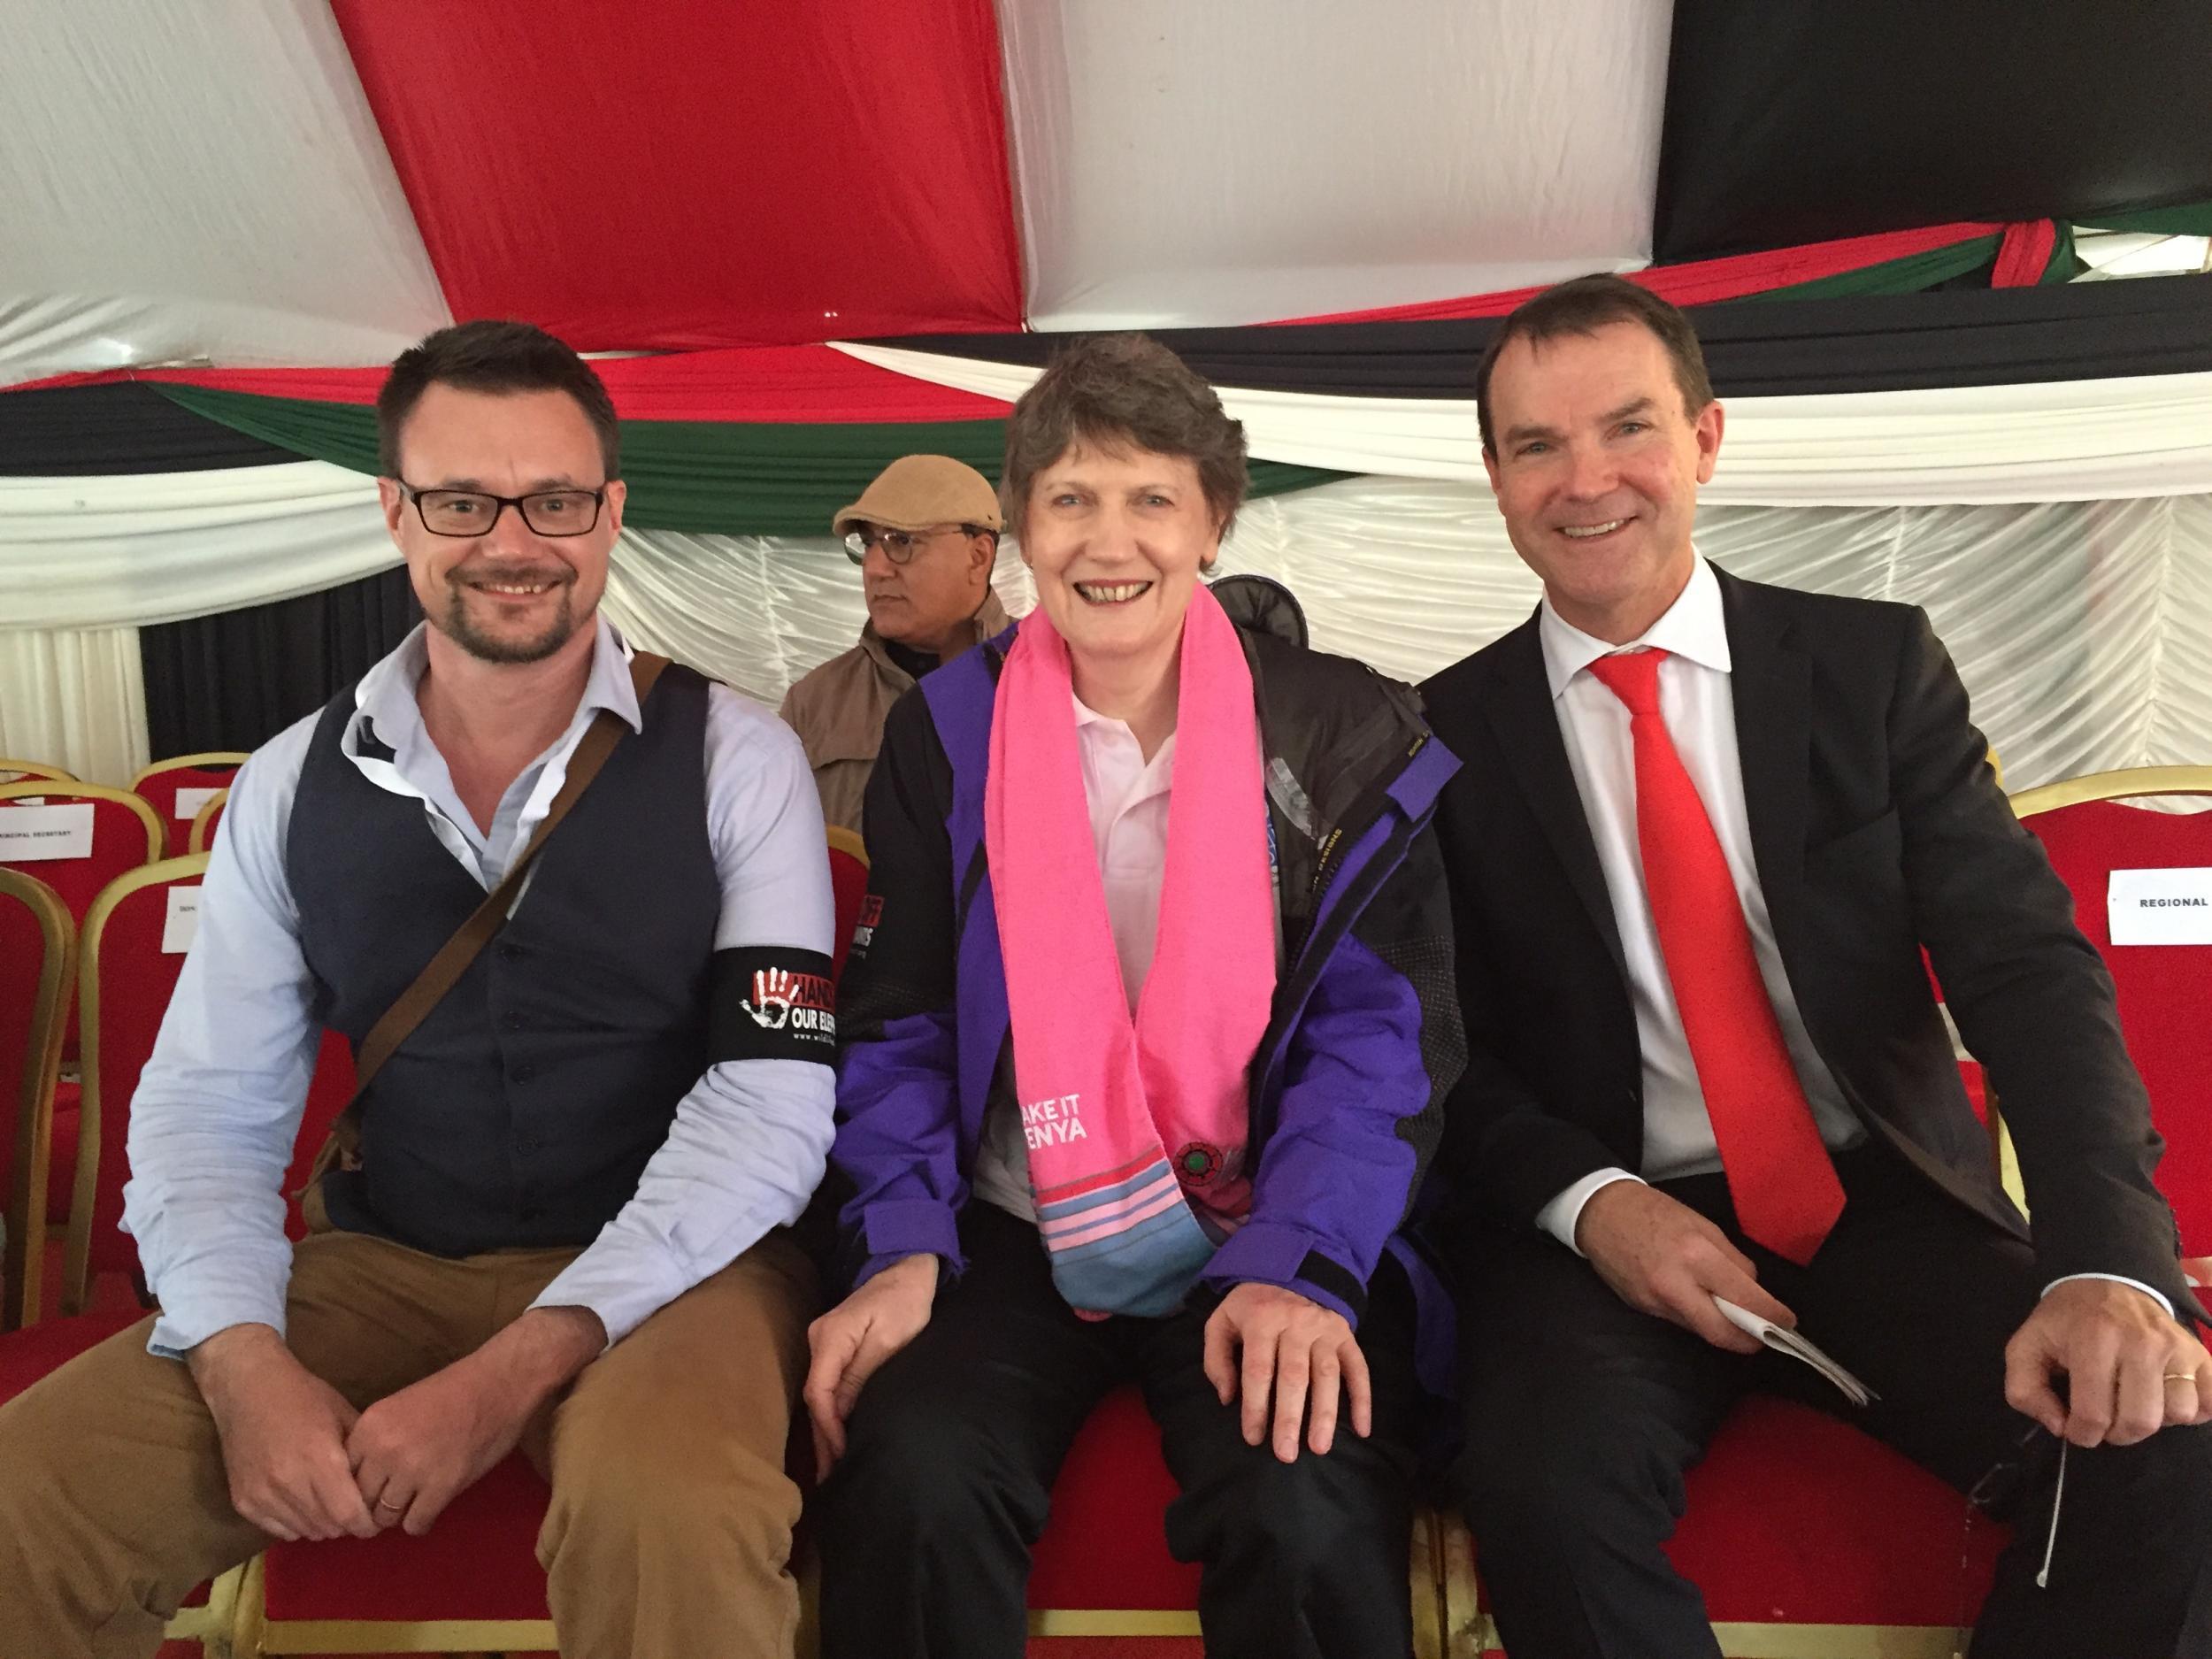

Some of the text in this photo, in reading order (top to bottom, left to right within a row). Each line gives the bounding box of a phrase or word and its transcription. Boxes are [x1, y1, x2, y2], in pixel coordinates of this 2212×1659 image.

[2139, 897, 2209, 908] REGIONAL
[791, 1007, 818, 1030] OUR
[1060, 1093, 1080, 1118] IT
[1024, 1117, 1087, 1149] ENYA
